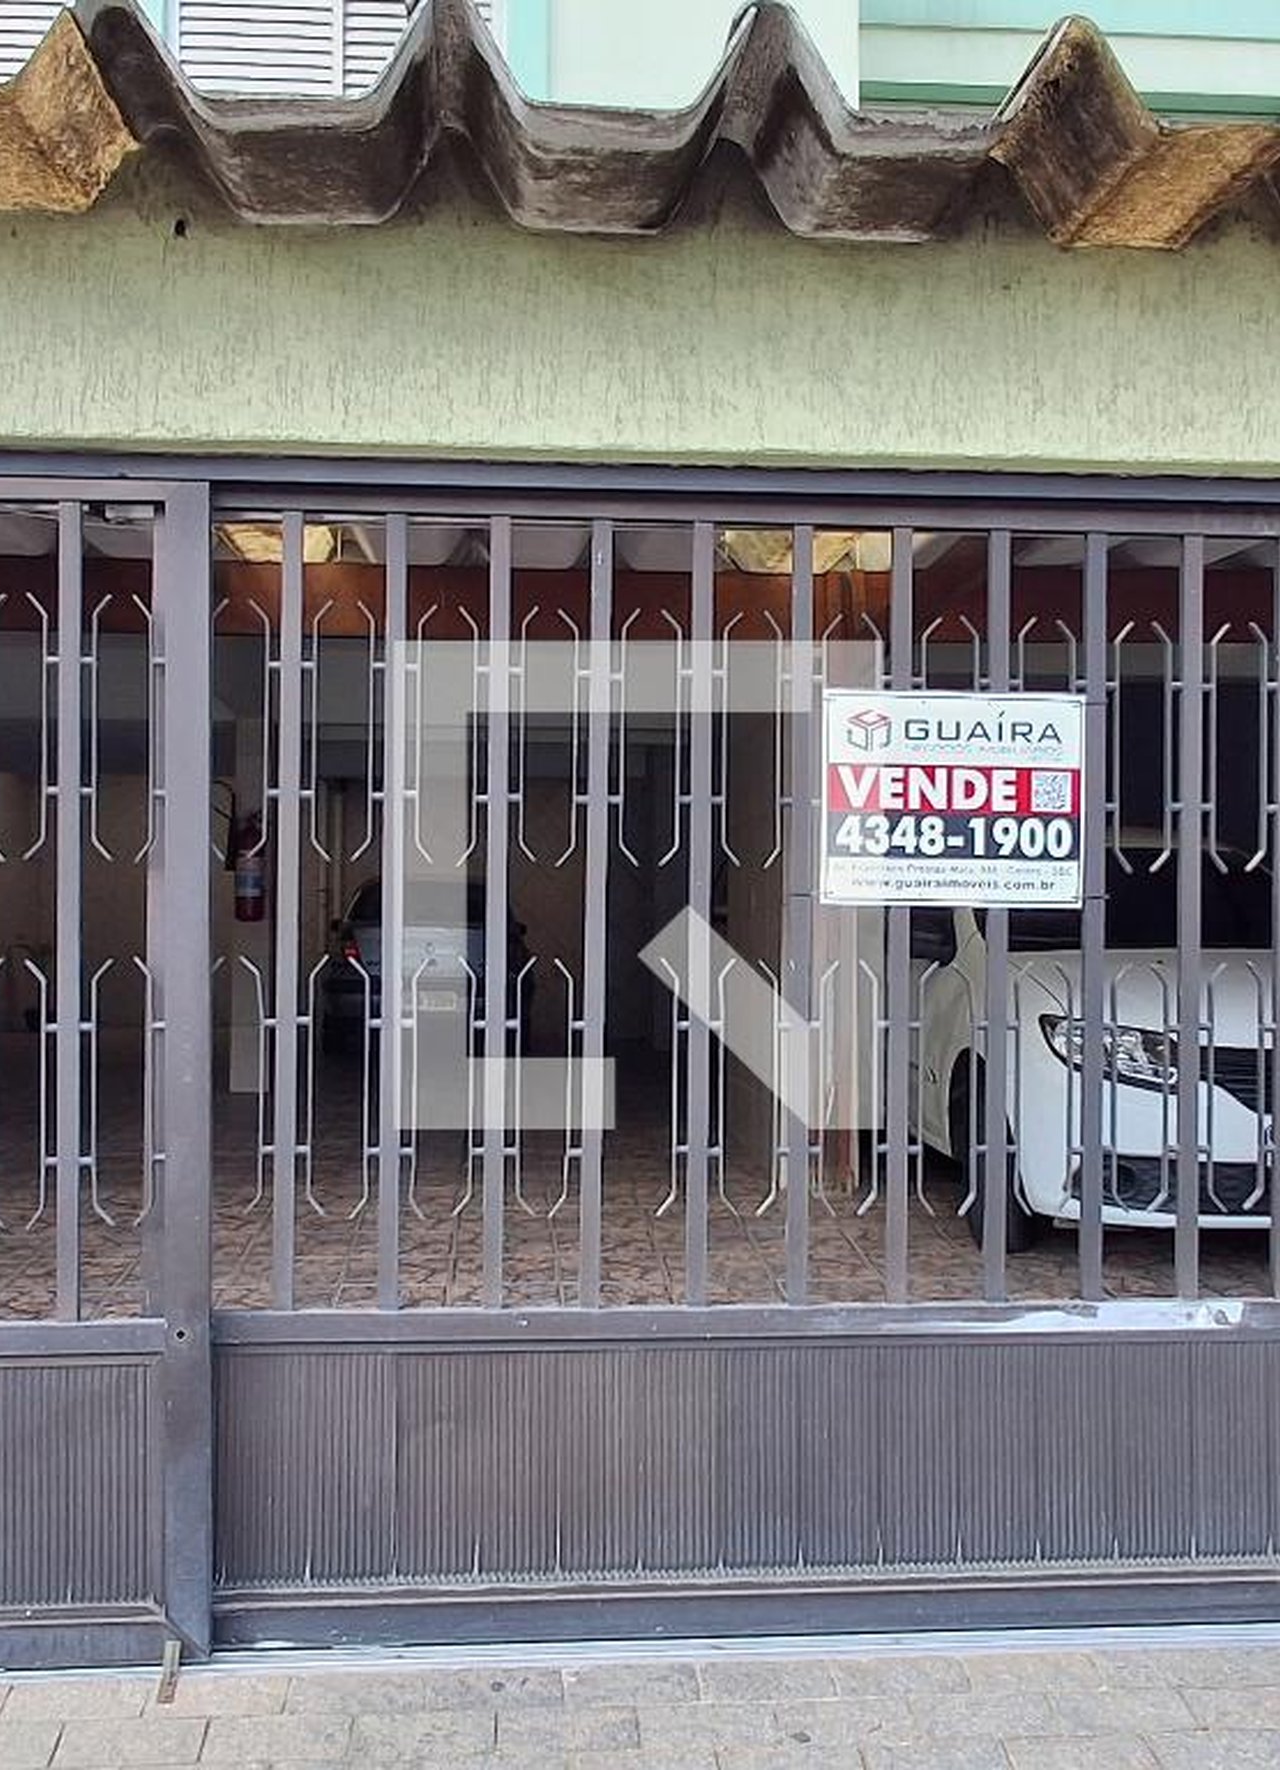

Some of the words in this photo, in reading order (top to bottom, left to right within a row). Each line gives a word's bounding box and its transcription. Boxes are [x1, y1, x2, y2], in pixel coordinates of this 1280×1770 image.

[904, 710, 1063, 744] GUAÍRA
[837, 764, 1017, 813] VENDE
[835, 814, 1072, 859] 4348-1900
